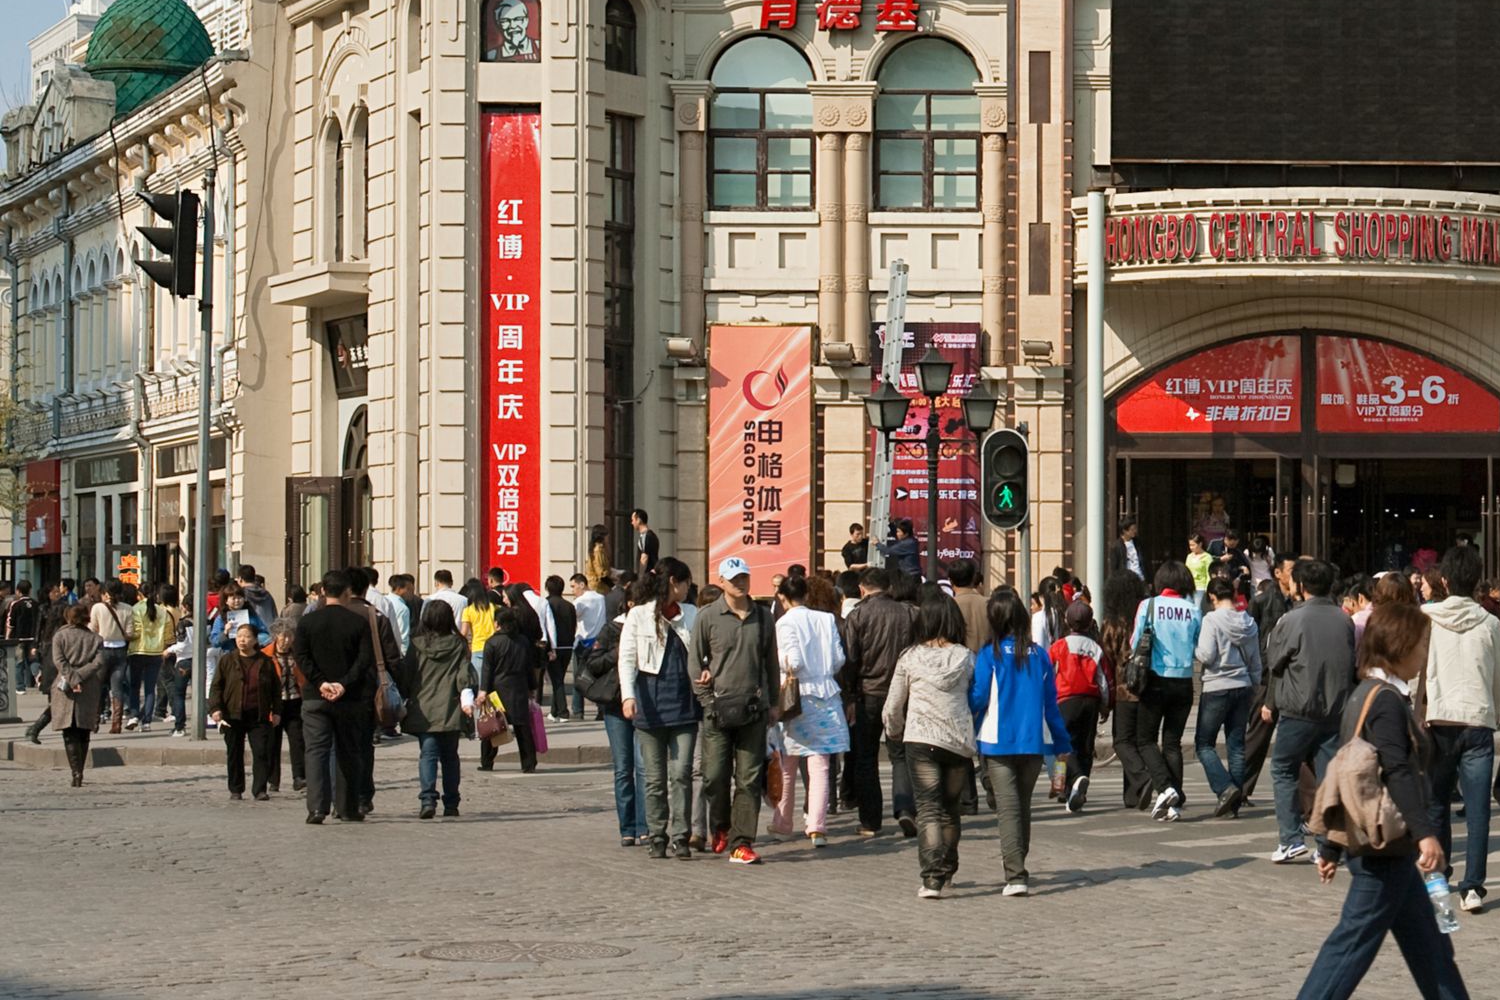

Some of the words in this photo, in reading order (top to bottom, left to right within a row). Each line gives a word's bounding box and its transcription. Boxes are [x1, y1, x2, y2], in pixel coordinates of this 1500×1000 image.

[1105, 213, 1197, 263] HONGBO
[1208, 211, 1321, 260] CENTRAL
[1333, 210, 1452, 262] SHOPPING
[1205, 406, 1292, 421] 非常折扣日
[743, 420, 756, 468] SEGO
[493, 443, 527, 556] VIP双倍积分
[756, 418, 783, 545] 申格体育
[742, 475, 756, 546] SPORTS
[1158, 606, 1192, 621] ROMA
